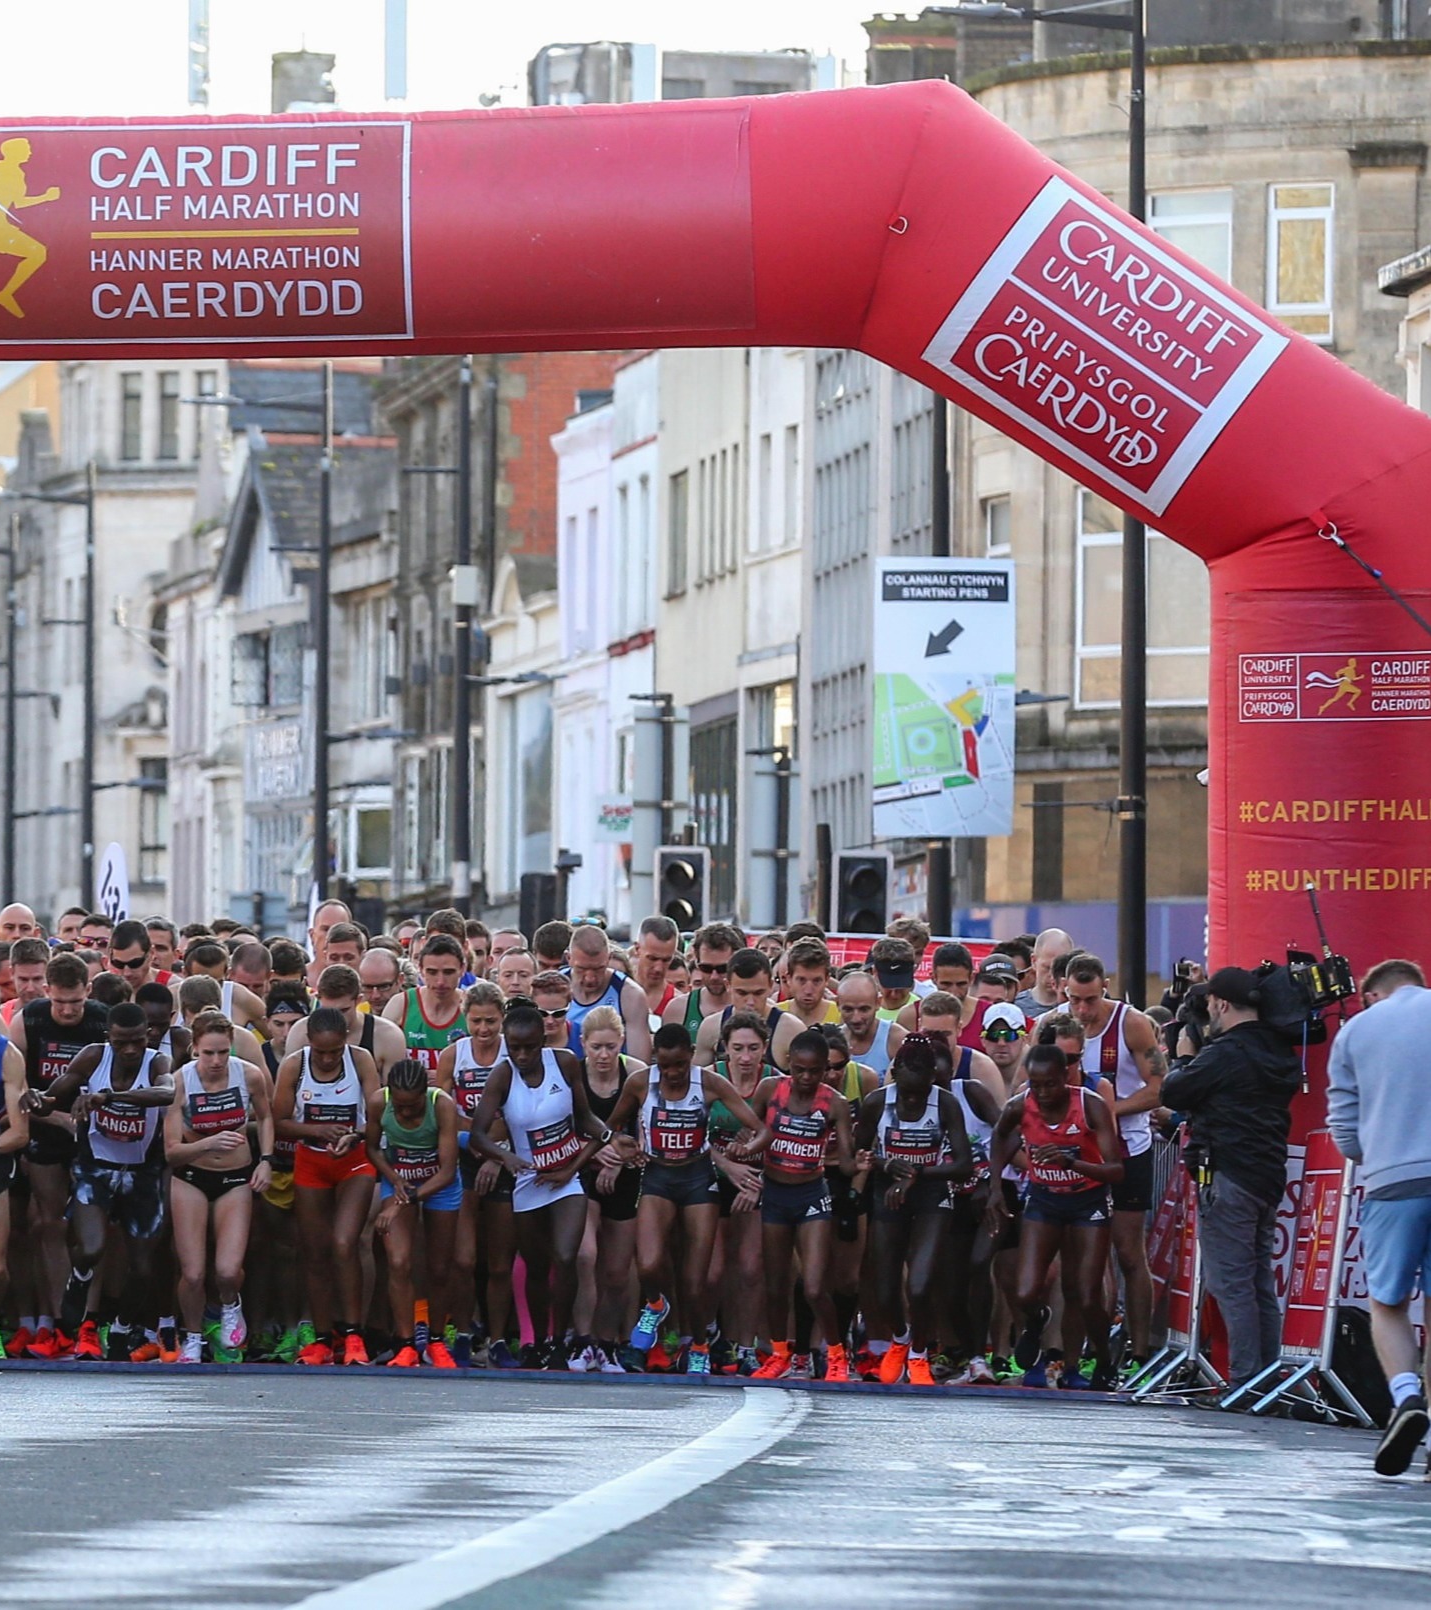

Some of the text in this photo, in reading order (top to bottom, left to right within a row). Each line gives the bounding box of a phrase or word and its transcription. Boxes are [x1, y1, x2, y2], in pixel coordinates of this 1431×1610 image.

[90, 144, 359, 188] CARDIFF
[90, 191, 359, 222] HALF MARATHON
[90, 246, 359, 272] HANNER MARATHON
[1058, 219, 1248, 354] CARDIFF
[91, 279, 362, 318] CAERDYDD
[1042, 257, 1215, 382] UNIVERSITY
[1004, 305, 1167, 434] PRIFYSGOL
[885, 575, 1005, 587] COLANNAU CYCHWYN
[902, 588, 989, 599] STARTING PENS
[1243, 658, 1295, 675] CARDIFF
[1371, 660, 1431, 676] CARDIFF
[1244, 676, 1293, 684] UNIVERSITY
[1371, 698, 1431, 711] CAERDYDD
[95, 1111, 145, 1133] LANGAT
[659, 1133, 694, 1149] TELE
[770, 1138, 820, 1158] KIPKOECH
[533, 1137, 580, 1168] WANJIKU
[1033, 1167, 1084, 1181] MATHATH
